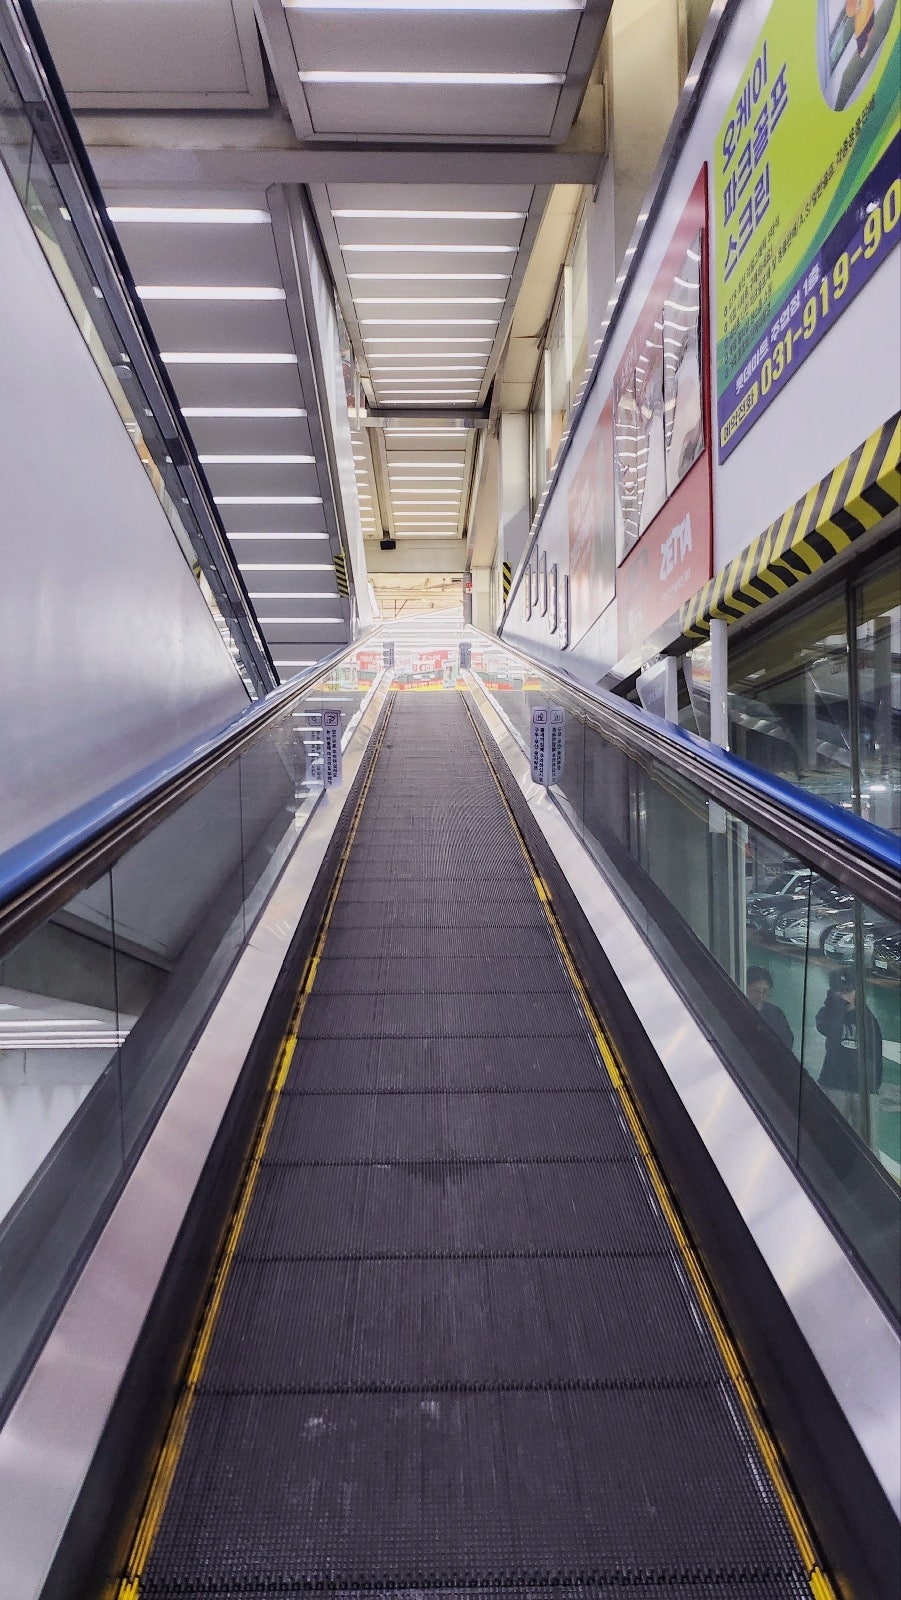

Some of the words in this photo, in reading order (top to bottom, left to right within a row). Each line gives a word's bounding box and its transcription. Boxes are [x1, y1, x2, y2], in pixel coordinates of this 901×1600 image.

[723, 40, 767, 174] 오케이
[724, 62, 788, 228] 파크골프
[724, 161, 770, 283] 스크린
[761, 178, 901, 395] 031-919-90
[735, 336, 769, 395] 롯데마트
[802, 264, 820, 297] 1층
[660, 512, 692, 580] ZETTA
